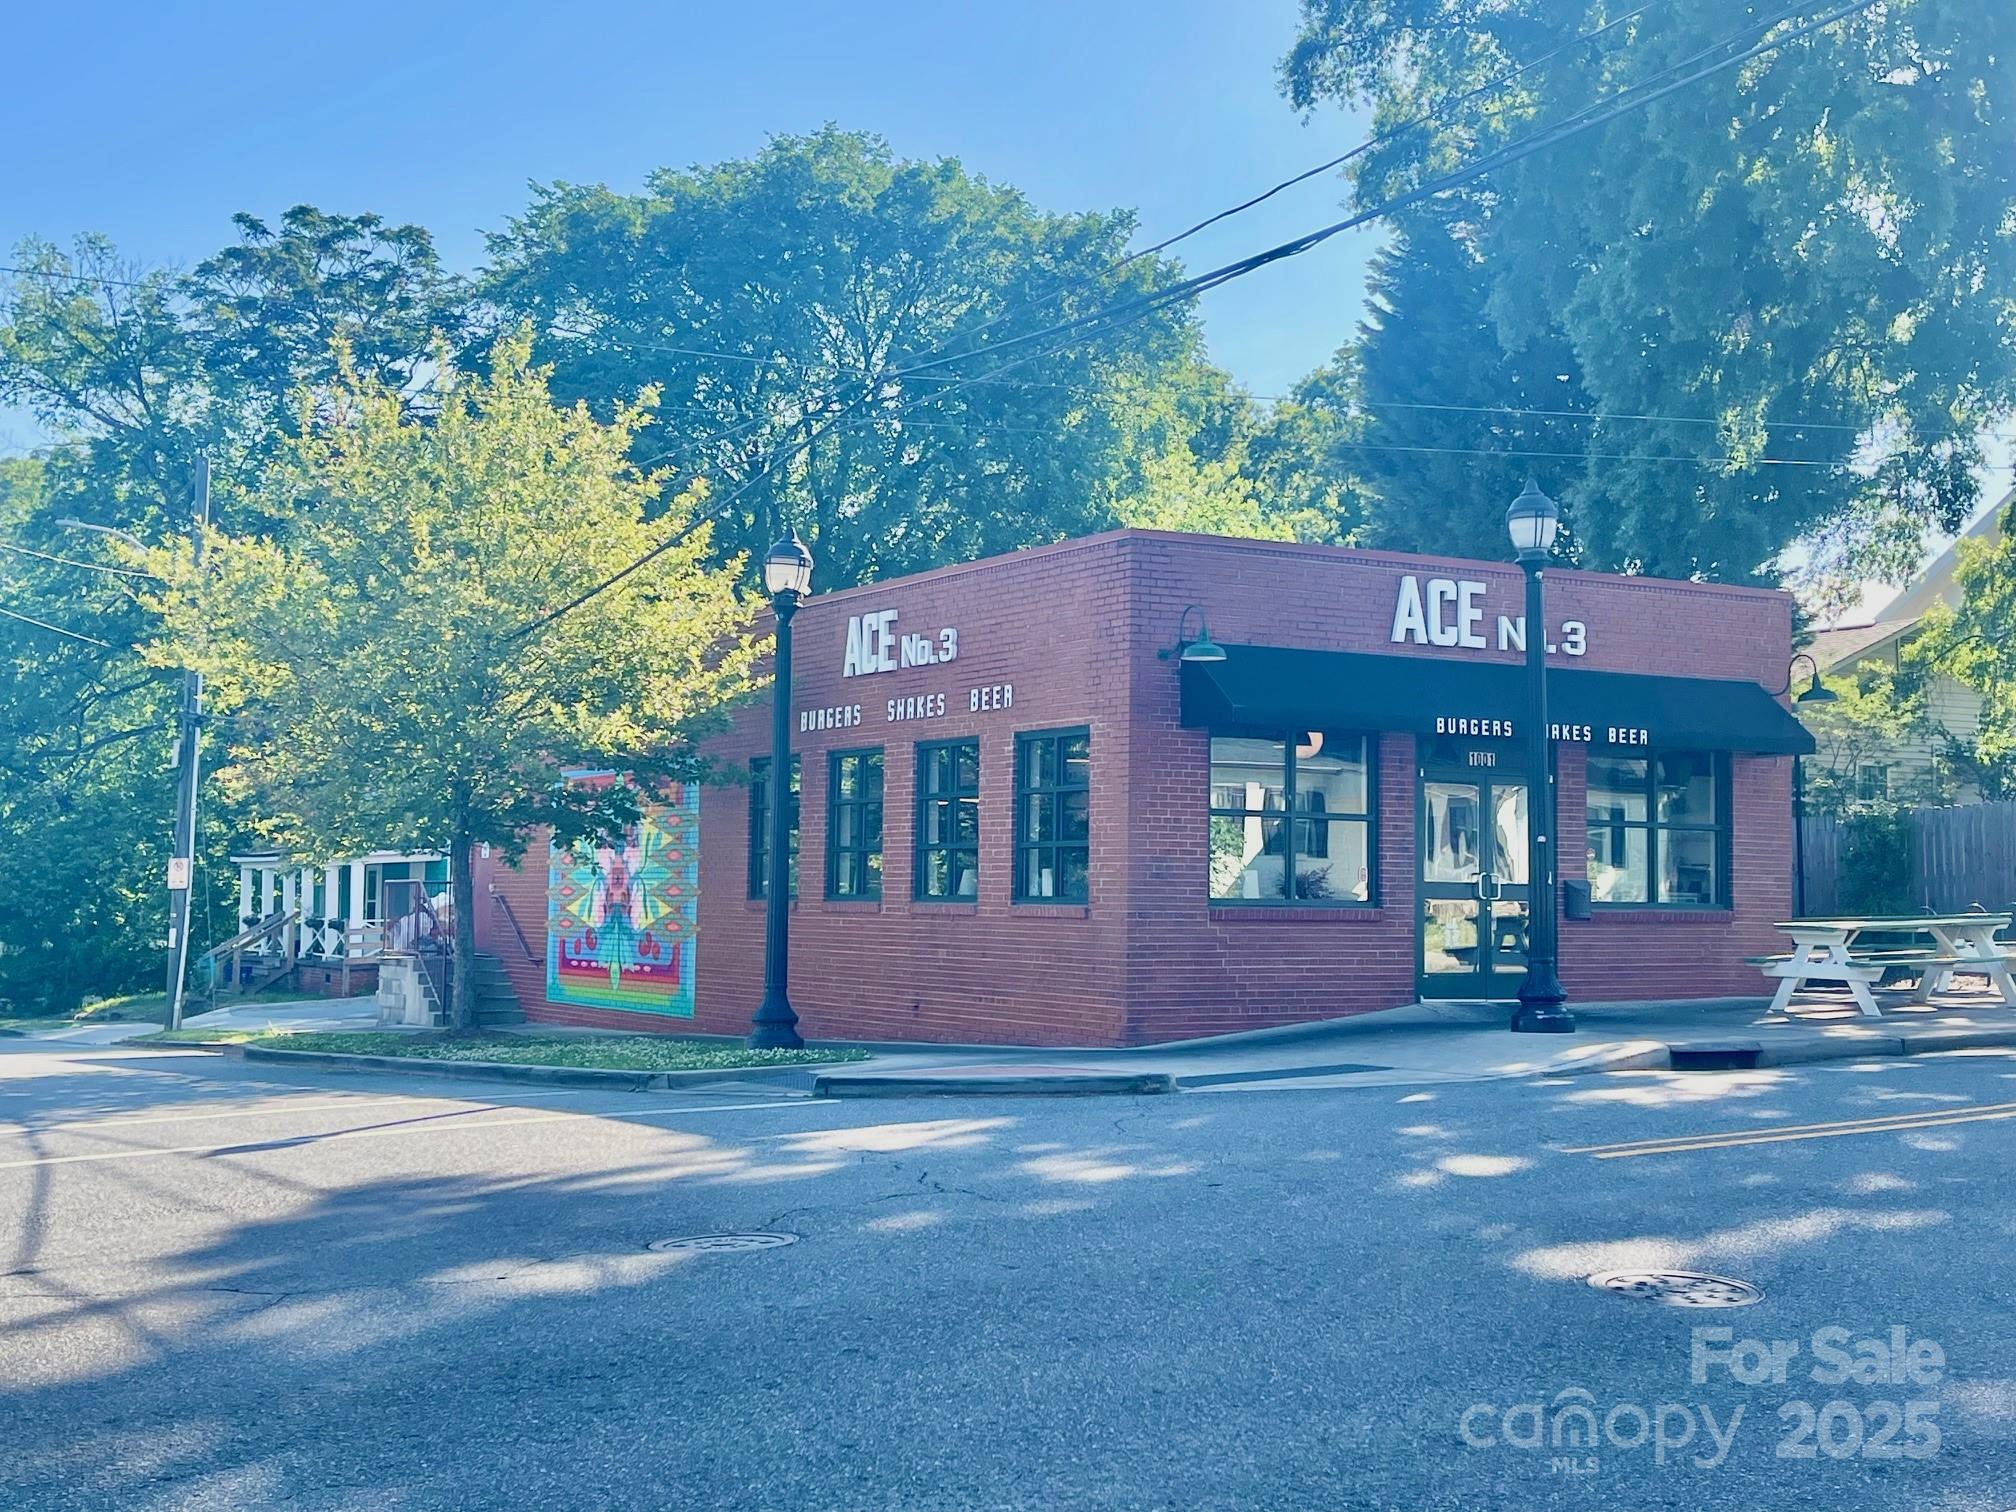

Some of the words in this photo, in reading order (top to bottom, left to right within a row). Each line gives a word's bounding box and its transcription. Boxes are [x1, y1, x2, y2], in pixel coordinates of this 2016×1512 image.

[1391, 575, 1486, 649] ACE
[1498, 616, 1587, 656] N.3
[843, 609, 898, 677] ACE
[800, 704, 861, 732] BURGERS
[887, 693, 945, 721] SHAKES
[969, 684, 1013, 712] BEER
[1436, 717, 1512, 737] BURGERS
[1546, 723, 1592, 742] AKES
[1608, 727, 1648, 746] BEER
[1469, 752, 1496, 767] 1001
